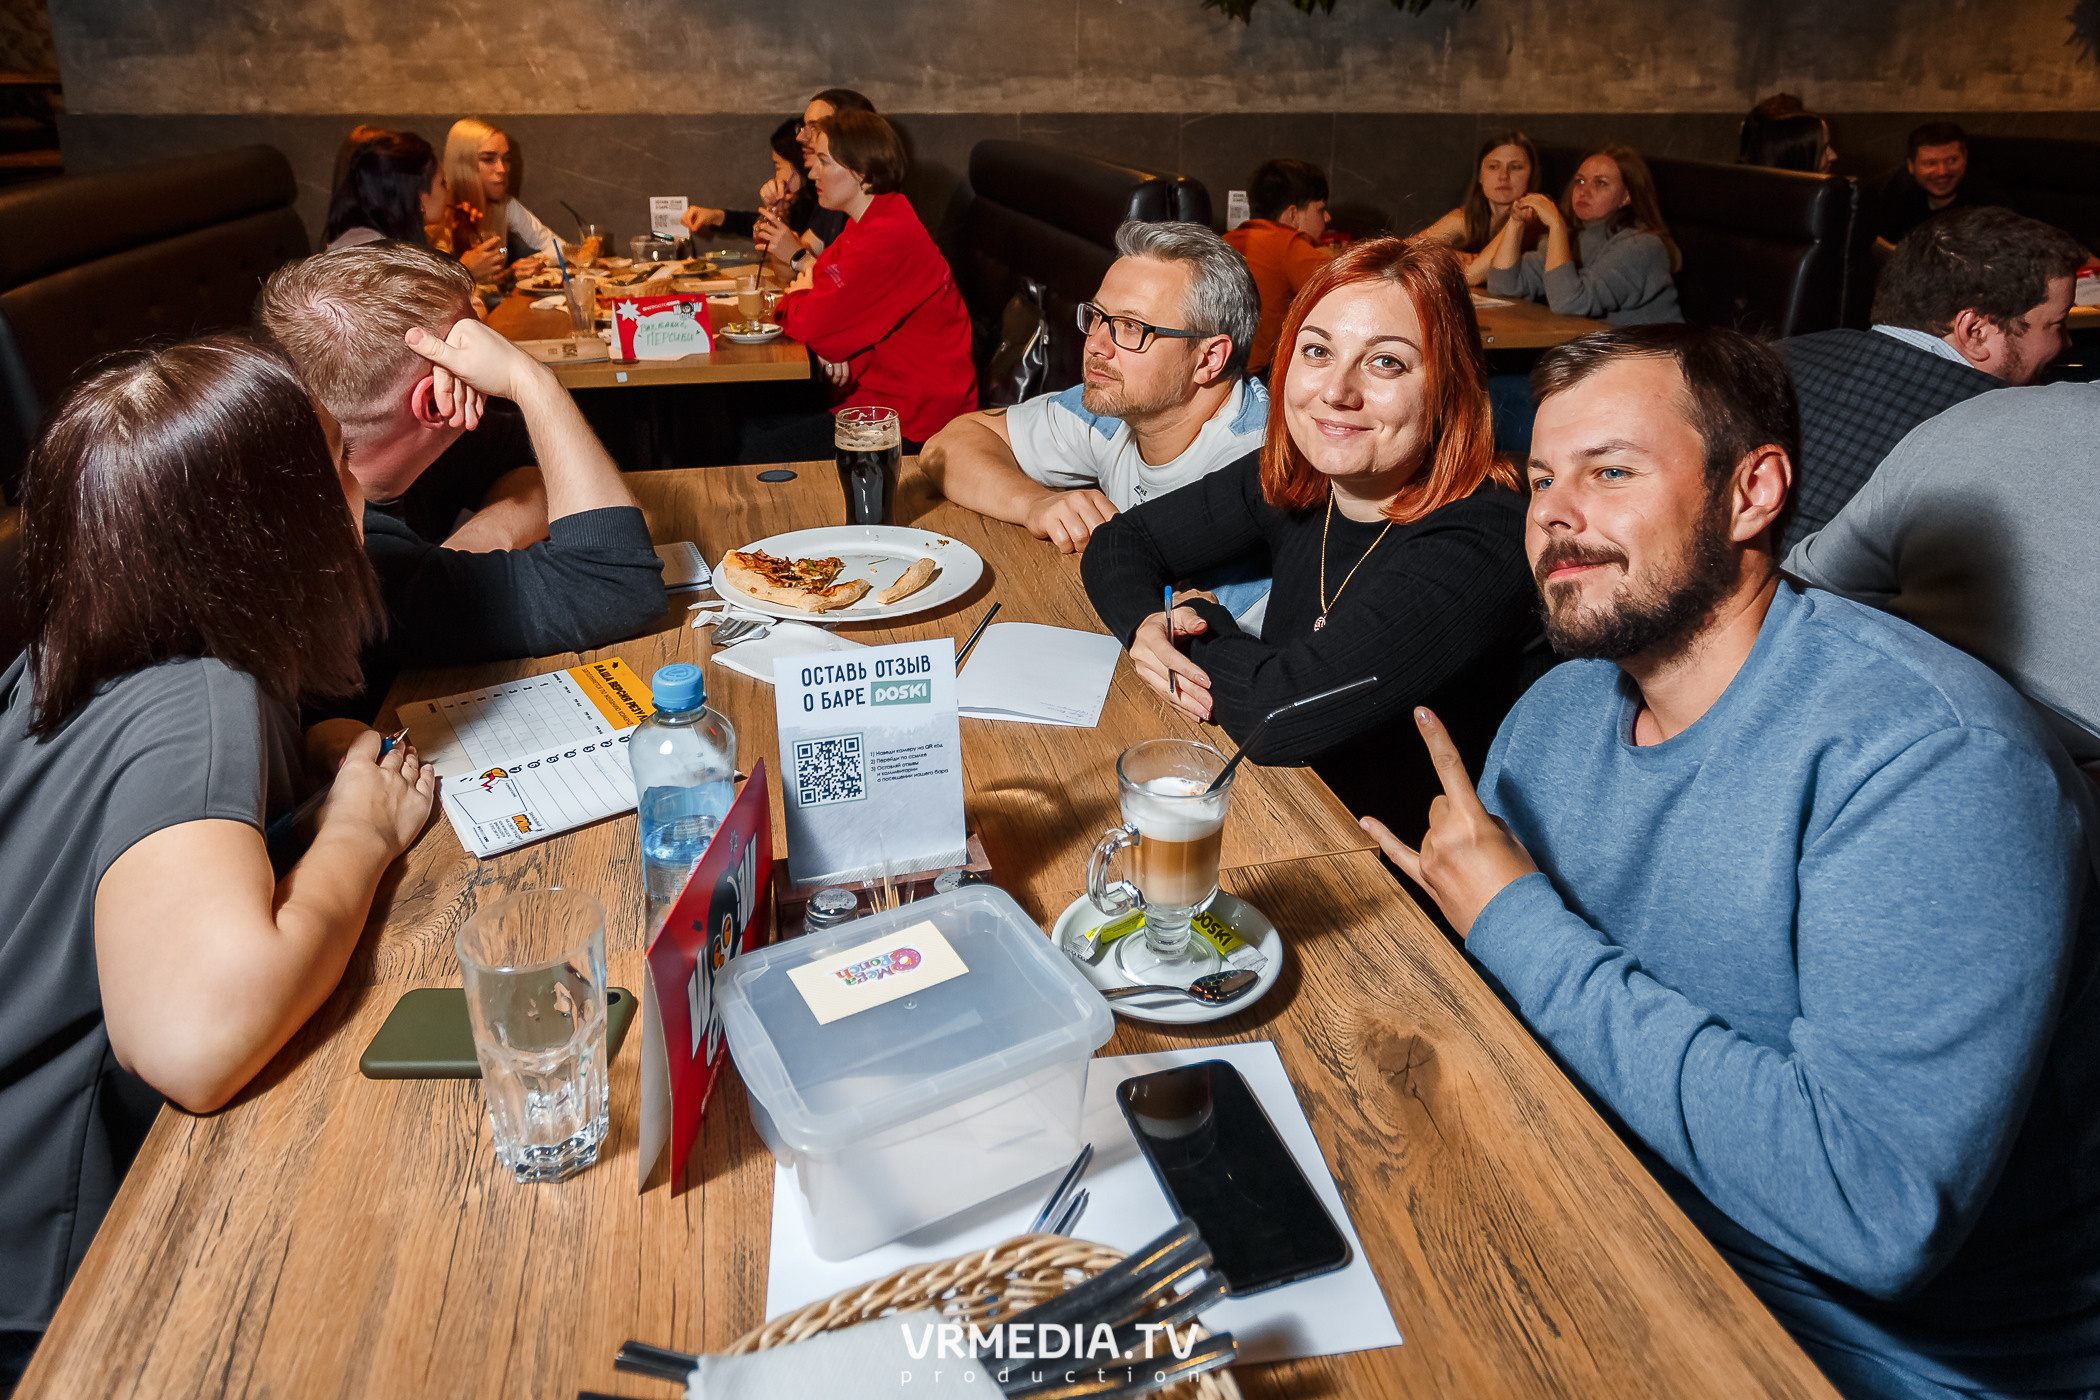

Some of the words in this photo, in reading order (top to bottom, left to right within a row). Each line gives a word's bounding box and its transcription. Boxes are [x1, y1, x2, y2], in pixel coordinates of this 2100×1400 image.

[593, 664, 614, 682] ВАША
[801, 662, 867, 687] ОСТАВЬ
[875, 654, 931, 678] ОТЗЫВ
[803, 693, 814, 712] О
[821, 687, 866, 710] БАРЕ
[875, 682, 927, 702] DOSKI
[835, 953, 897, 979] Ponch
[844, 966, 895, 986] Mega
